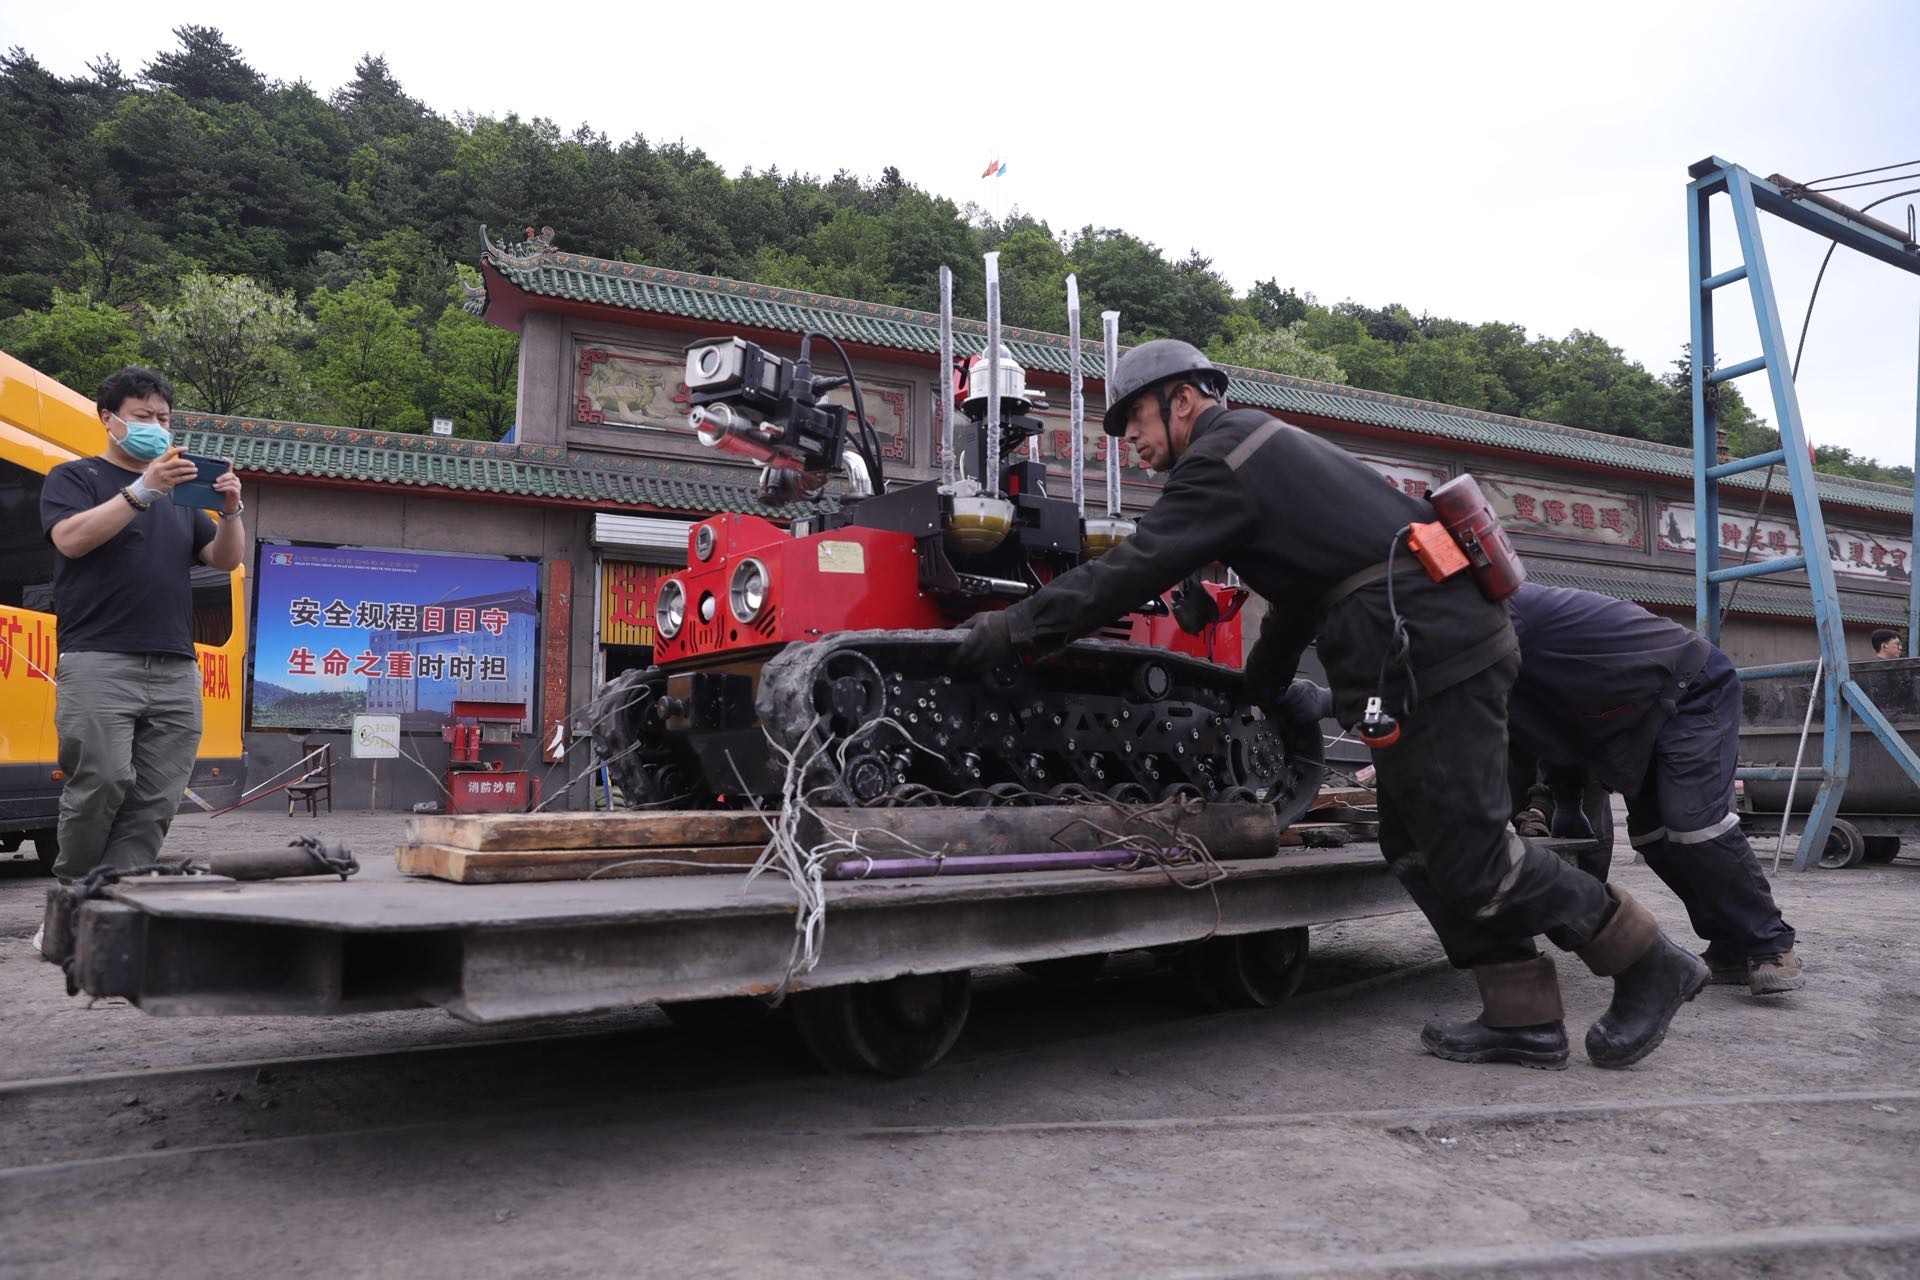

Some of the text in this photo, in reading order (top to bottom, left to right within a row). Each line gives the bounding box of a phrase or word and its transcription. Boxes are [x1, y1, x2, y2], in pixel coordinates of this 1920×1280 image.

[1513, 493, 1623, 534] 整体推进
[290, 597, 509, 635] 安全规程日日守
[196, 651, 231, 700] 阳队
[287, 646, 508, 681] 生命之重时时担
